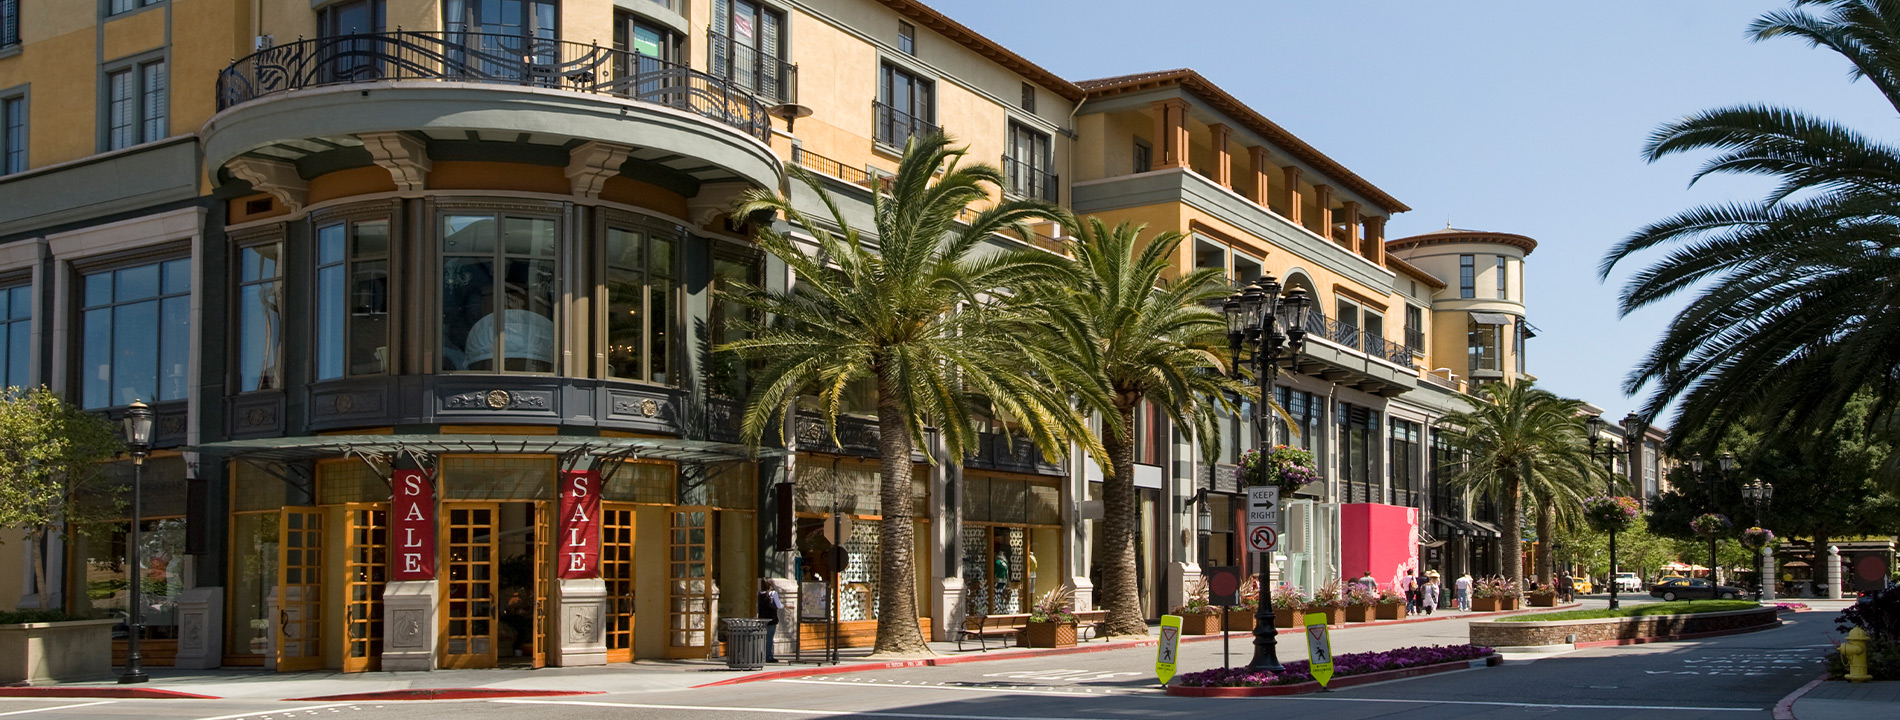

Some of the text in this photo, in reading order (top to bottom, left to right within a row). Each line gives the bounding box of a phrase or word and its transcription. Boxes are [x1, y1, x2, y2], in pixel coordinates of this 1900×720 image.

[1250, 511, 1276, 520] RIGHT
[1252, 491, 1274, 499] KEEP
[403, 474, 425, 573] SALE
[568, 476, 590, 572] SALE
